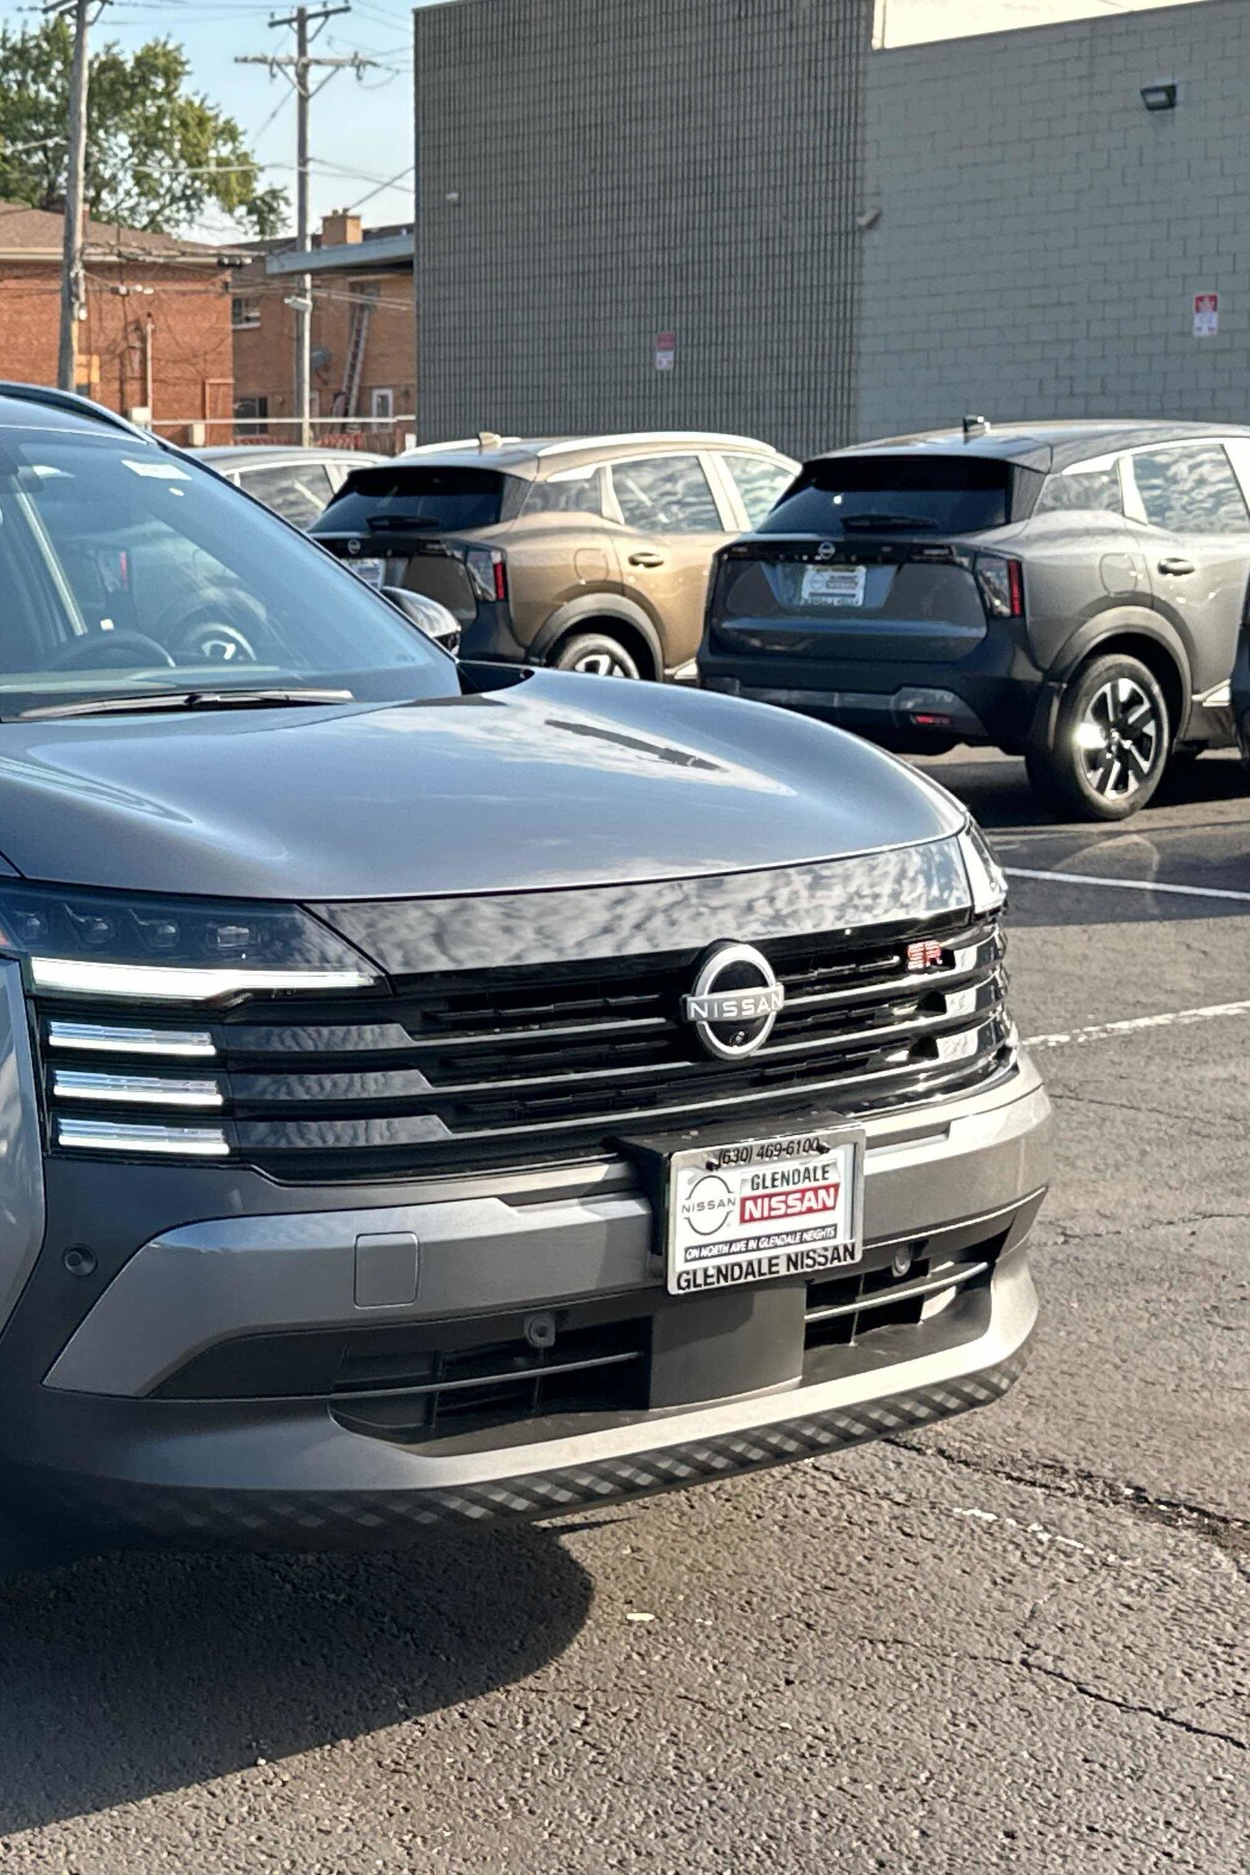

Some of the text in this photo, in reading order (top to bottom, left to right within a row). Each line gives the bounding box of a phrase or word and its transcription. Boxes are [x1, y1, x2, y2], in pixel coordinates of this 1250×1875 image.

[690, 988, 784, 1019] NISSAN
[717, 1137, 820, 1170] (630) 469-6100
[751, 1164, 830, 1192] GLENDALE
[681, 1197, 736, 1214] NISSAN
[743, 1187, 836, 1220] NISSAN
[686, 1226, 836, 1260] ON NORTH AVE IN GLENDALE HEIGHTS
[676, 1242, 855, 1292] GLENDALE NISSAN
